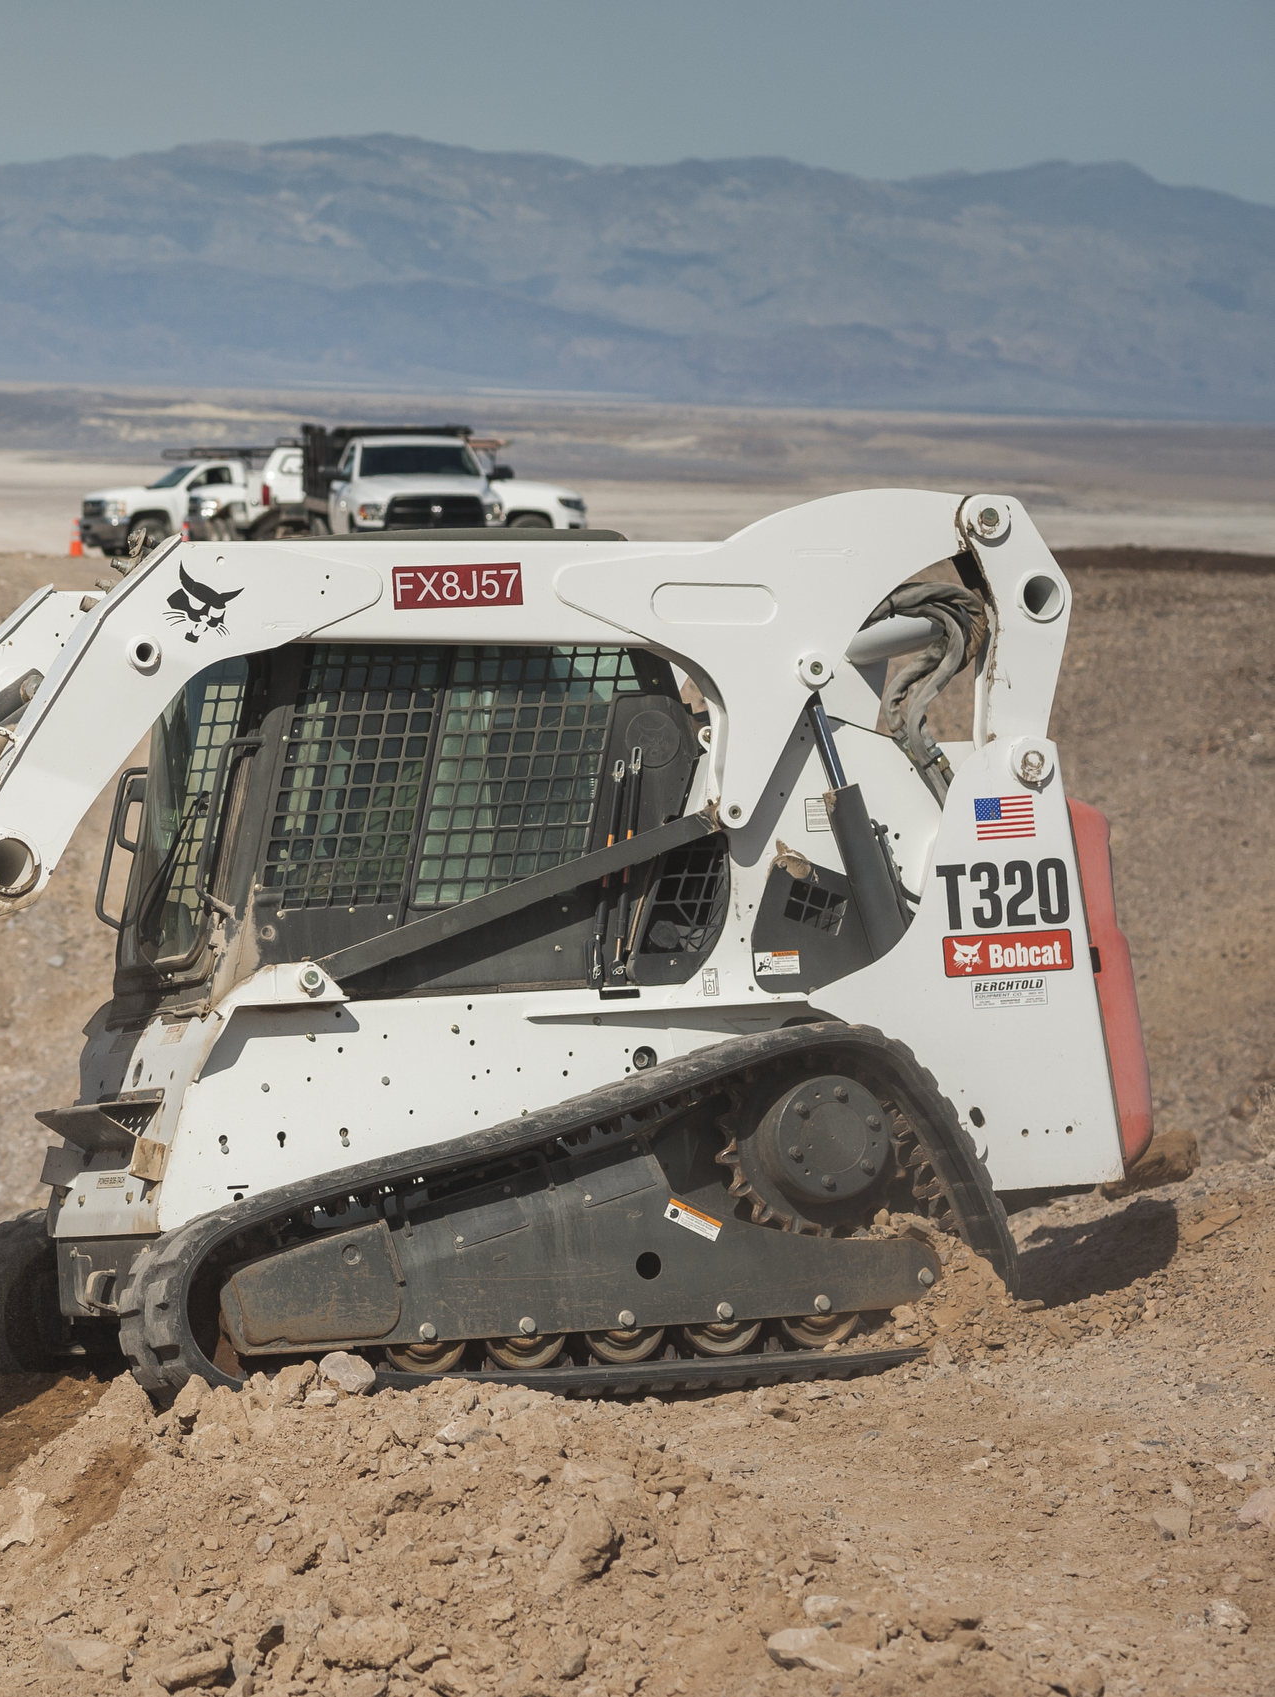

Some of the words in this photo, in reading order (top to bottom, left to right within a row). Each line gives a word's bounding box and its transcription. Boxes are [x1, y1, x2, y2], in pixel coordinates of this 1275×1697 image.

[395, 569, 519, 602] FX8J57
[936, 858, 1070, 930] T320
[988, 941, 1063, 968] Bobcat
[974, 979, 1043, 992] BERCHTOLD
